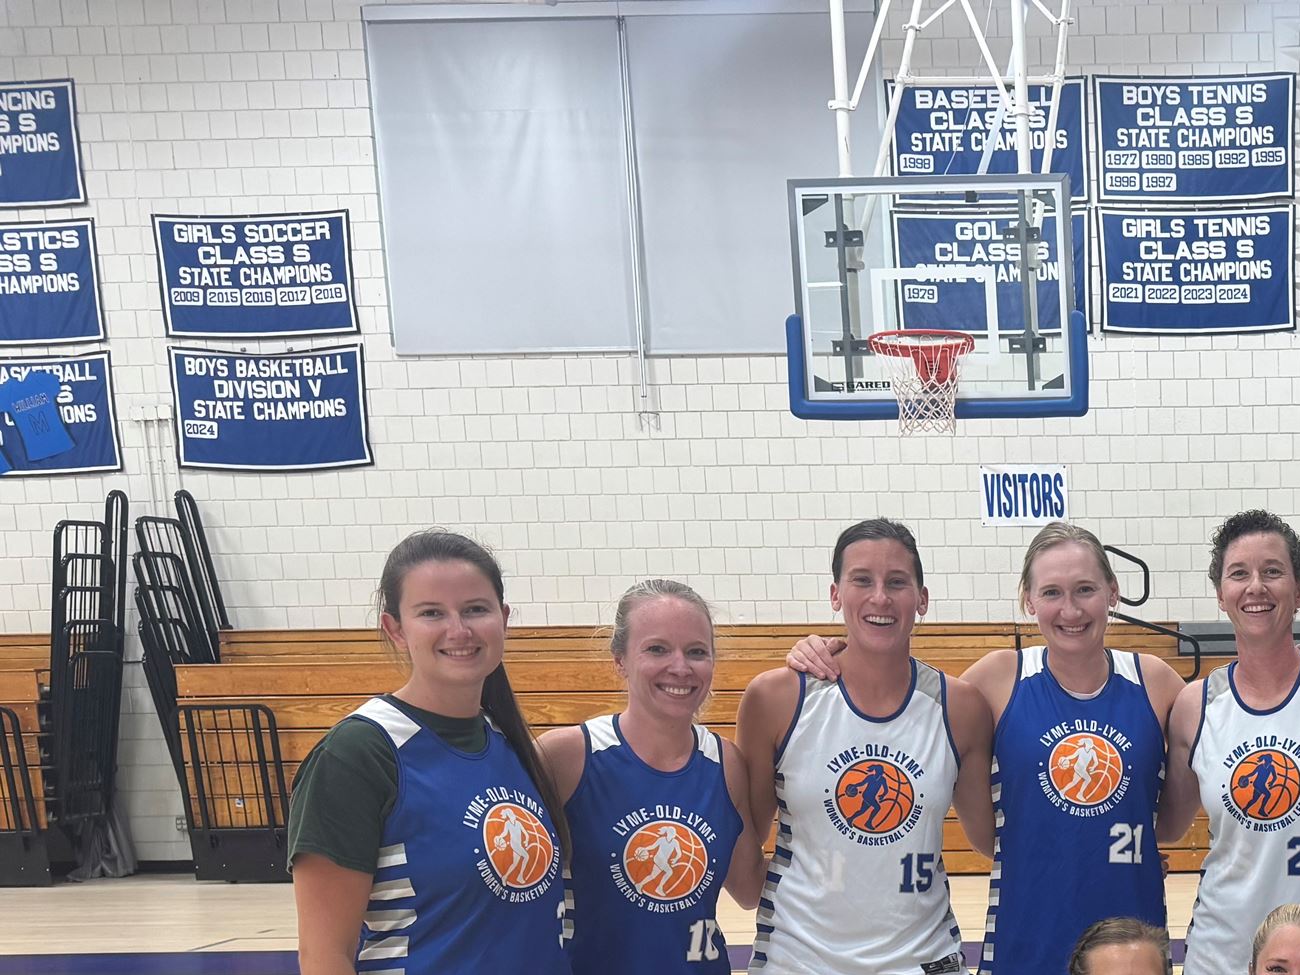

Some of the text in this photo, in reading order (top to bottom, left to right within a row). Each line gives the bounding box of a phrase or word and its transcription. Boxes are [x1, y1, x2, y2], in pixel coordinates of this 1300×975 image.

[1122, 84, 1267, 105] BOYS TENNIS
[18, 112, 37, 132] S
[1136, 105, 1253, 127] CLASS S
[0, 132, 60, 154] MPIONS
[911, 132, 964, 152] STATE
[1116, 125, 1274, 148] STATE CHAMPIONS
[903, 157, 931, 169] 1998
[1107, 150, 1283, 166] 1977 1980 1985 1992 1995
[1109, 176, 1173, 188] 1996 1997
[173, 221, 331, 244] GIRLS SOCCER
[1122, 216, 1270, 238] GIRLS TENNIS
[0, 230, 80, 251] STICS
[1139, 239, 1254, 260] CLASS S
[39, 253, 58, 271] S
[198, 244, 311, 265] CLASS S
[935, 242, 1021, 262] CLASS
[178, 263, 333, 286] STATE CHAMPIONS
[1122, 260, 1272, 282] STATE CHAMPIONS
[173, 287, 343, 303] 2009 2015 2016 2017 2018
[907, 287, 935, 300] 1979
[1112, 287, 1248, 300] 2021 2022 2023 2024
[184, 355, 348, 378] BOYS BASKETBALL
[214, 379, 322, 398] DIVISION V
[193, 398, 347, 421] STATE CHAMPIONS
[186, 423, 215, 435] 2024
[983, 472, 1065, 519] VISITORS
[1039, 719, 1132, 752] LYME-OLD-LYME
[826, 743, 925, 779] LYME-OLD-LYME
[1112, 776, 1131, 804] LEAGUE
[463, 786, 544, 829] LYME-OLD-LYME
[903, 804, 923, 833] LEAGUE
[612, 804, 717, 843] LYME-OLD-LYME
[1108, 823, 1143, 864] 21
[899, 853, 934, 893] 15
[695, 870, 715, 900] LEAGUE
